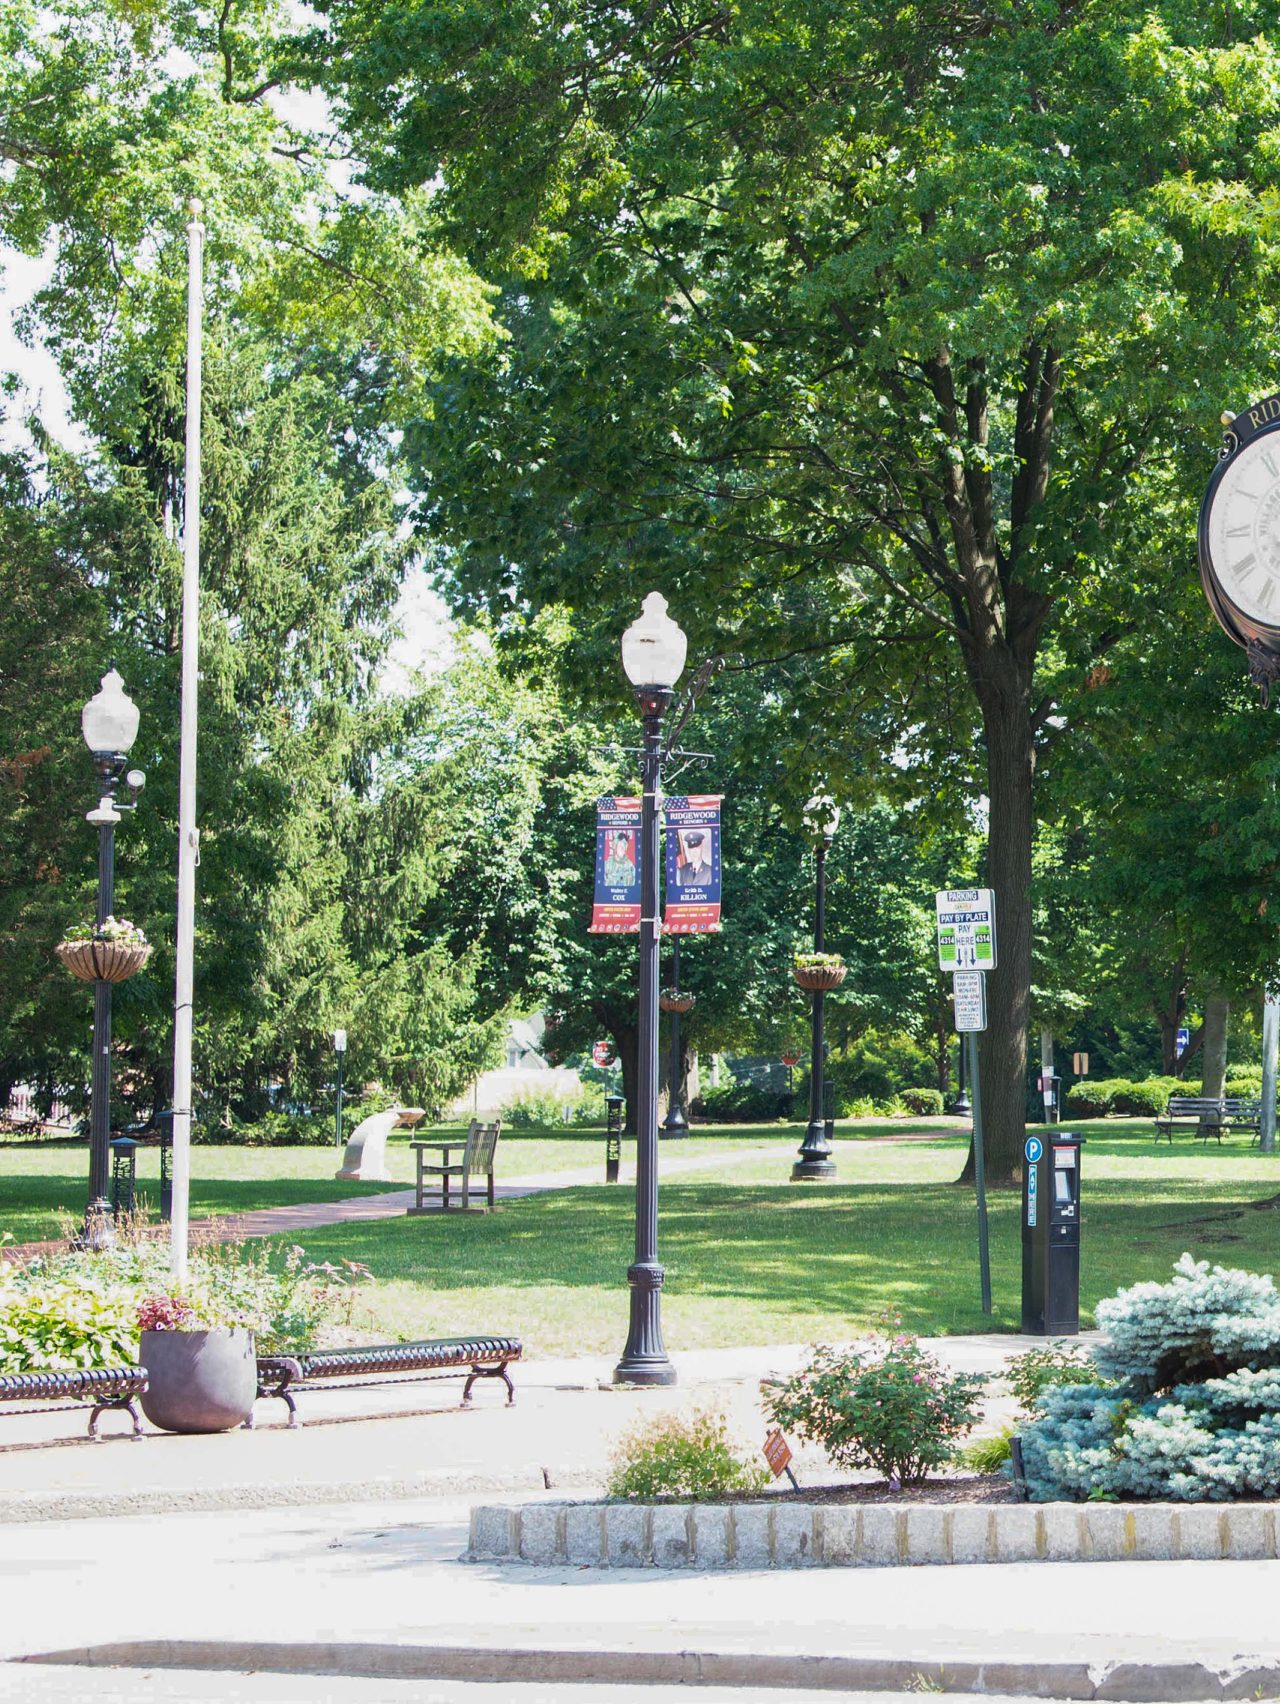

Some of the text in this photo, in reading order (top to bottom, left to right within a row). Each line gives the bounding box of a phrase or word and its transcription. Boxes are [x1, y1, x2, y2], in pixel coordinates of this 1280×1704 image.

[601, 813, 639, 821] RIDGEWOOD
[671, 812, 716, 821] RIDGEWOOD
[948, 891, 977, 901] PARKING
[941, 913, 987, 923] PAY BY PLATE
[958, 925, 971, 933] PAY
[956, 937, 974, 946] HERE
[1030, 1141, 1038, 1159] P
